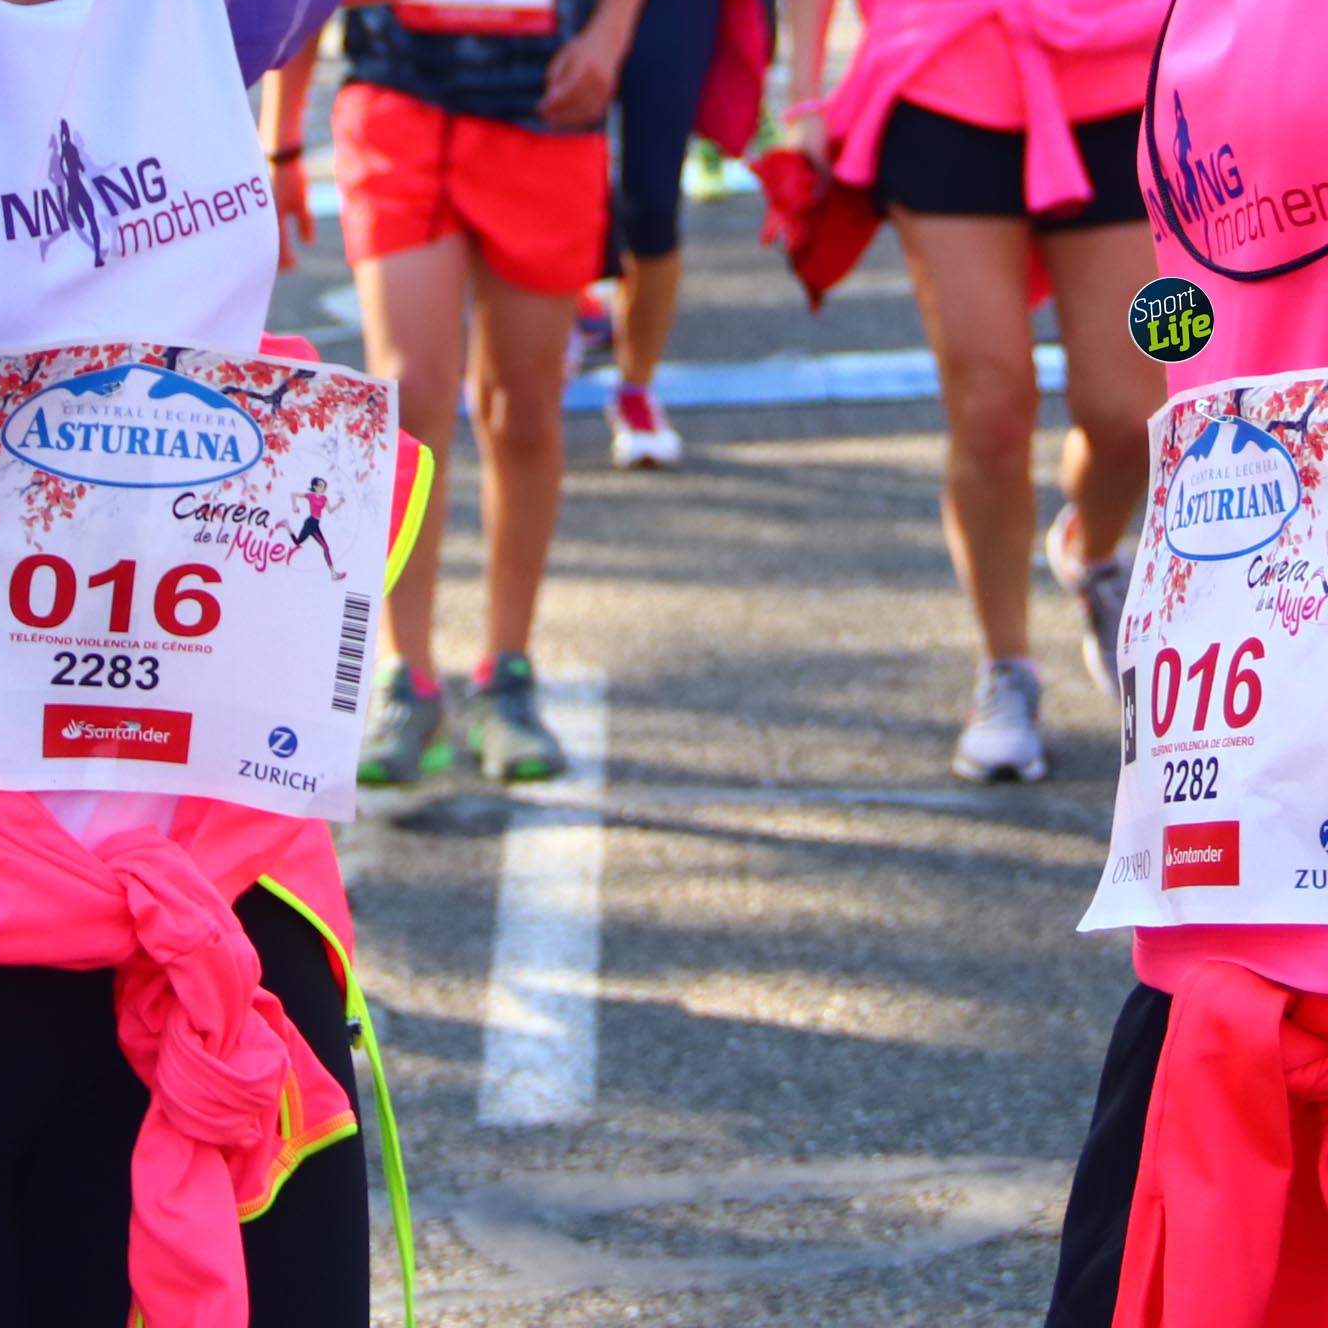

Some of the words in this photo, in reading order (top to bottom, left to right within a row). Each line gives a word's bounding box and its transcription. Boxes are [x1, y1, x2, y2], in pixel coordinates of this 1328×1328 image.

[118, 176, 269, 258] mothers
[62, 400, 144, 419] CENTRAL
[153, 408, 237, 429] LECHERA
[18, 406, 242, 464] ASTURIANA
[172, 492, 270, 529] Carrera
[1169, 480, 1286, 532] ASTURIANA
[193, 525, 212, 543] de
[216, 525, 230, 544] la
[225, 524, 302, 572] Mujer
[9, 553, 223, 637] 016
[9, 632, 73, 646] TELÉFONO
[75, 637, 140, 649] VIOLENCIA
[143, 641, 159, 650] DE
[162, 641, 213, 654] GÉNERO
[50, 651, 160, 690] 2283
[1150, 637, 1265, 738] 016
[84, 722, 171, 744] Santander
[238, 759, 318, 793] ZURICH
[1163, 756, 1219, 803] 2282
[1112, 849, 1151, 885] OYSHO
[1172, 845, 1224, 865] Santander
